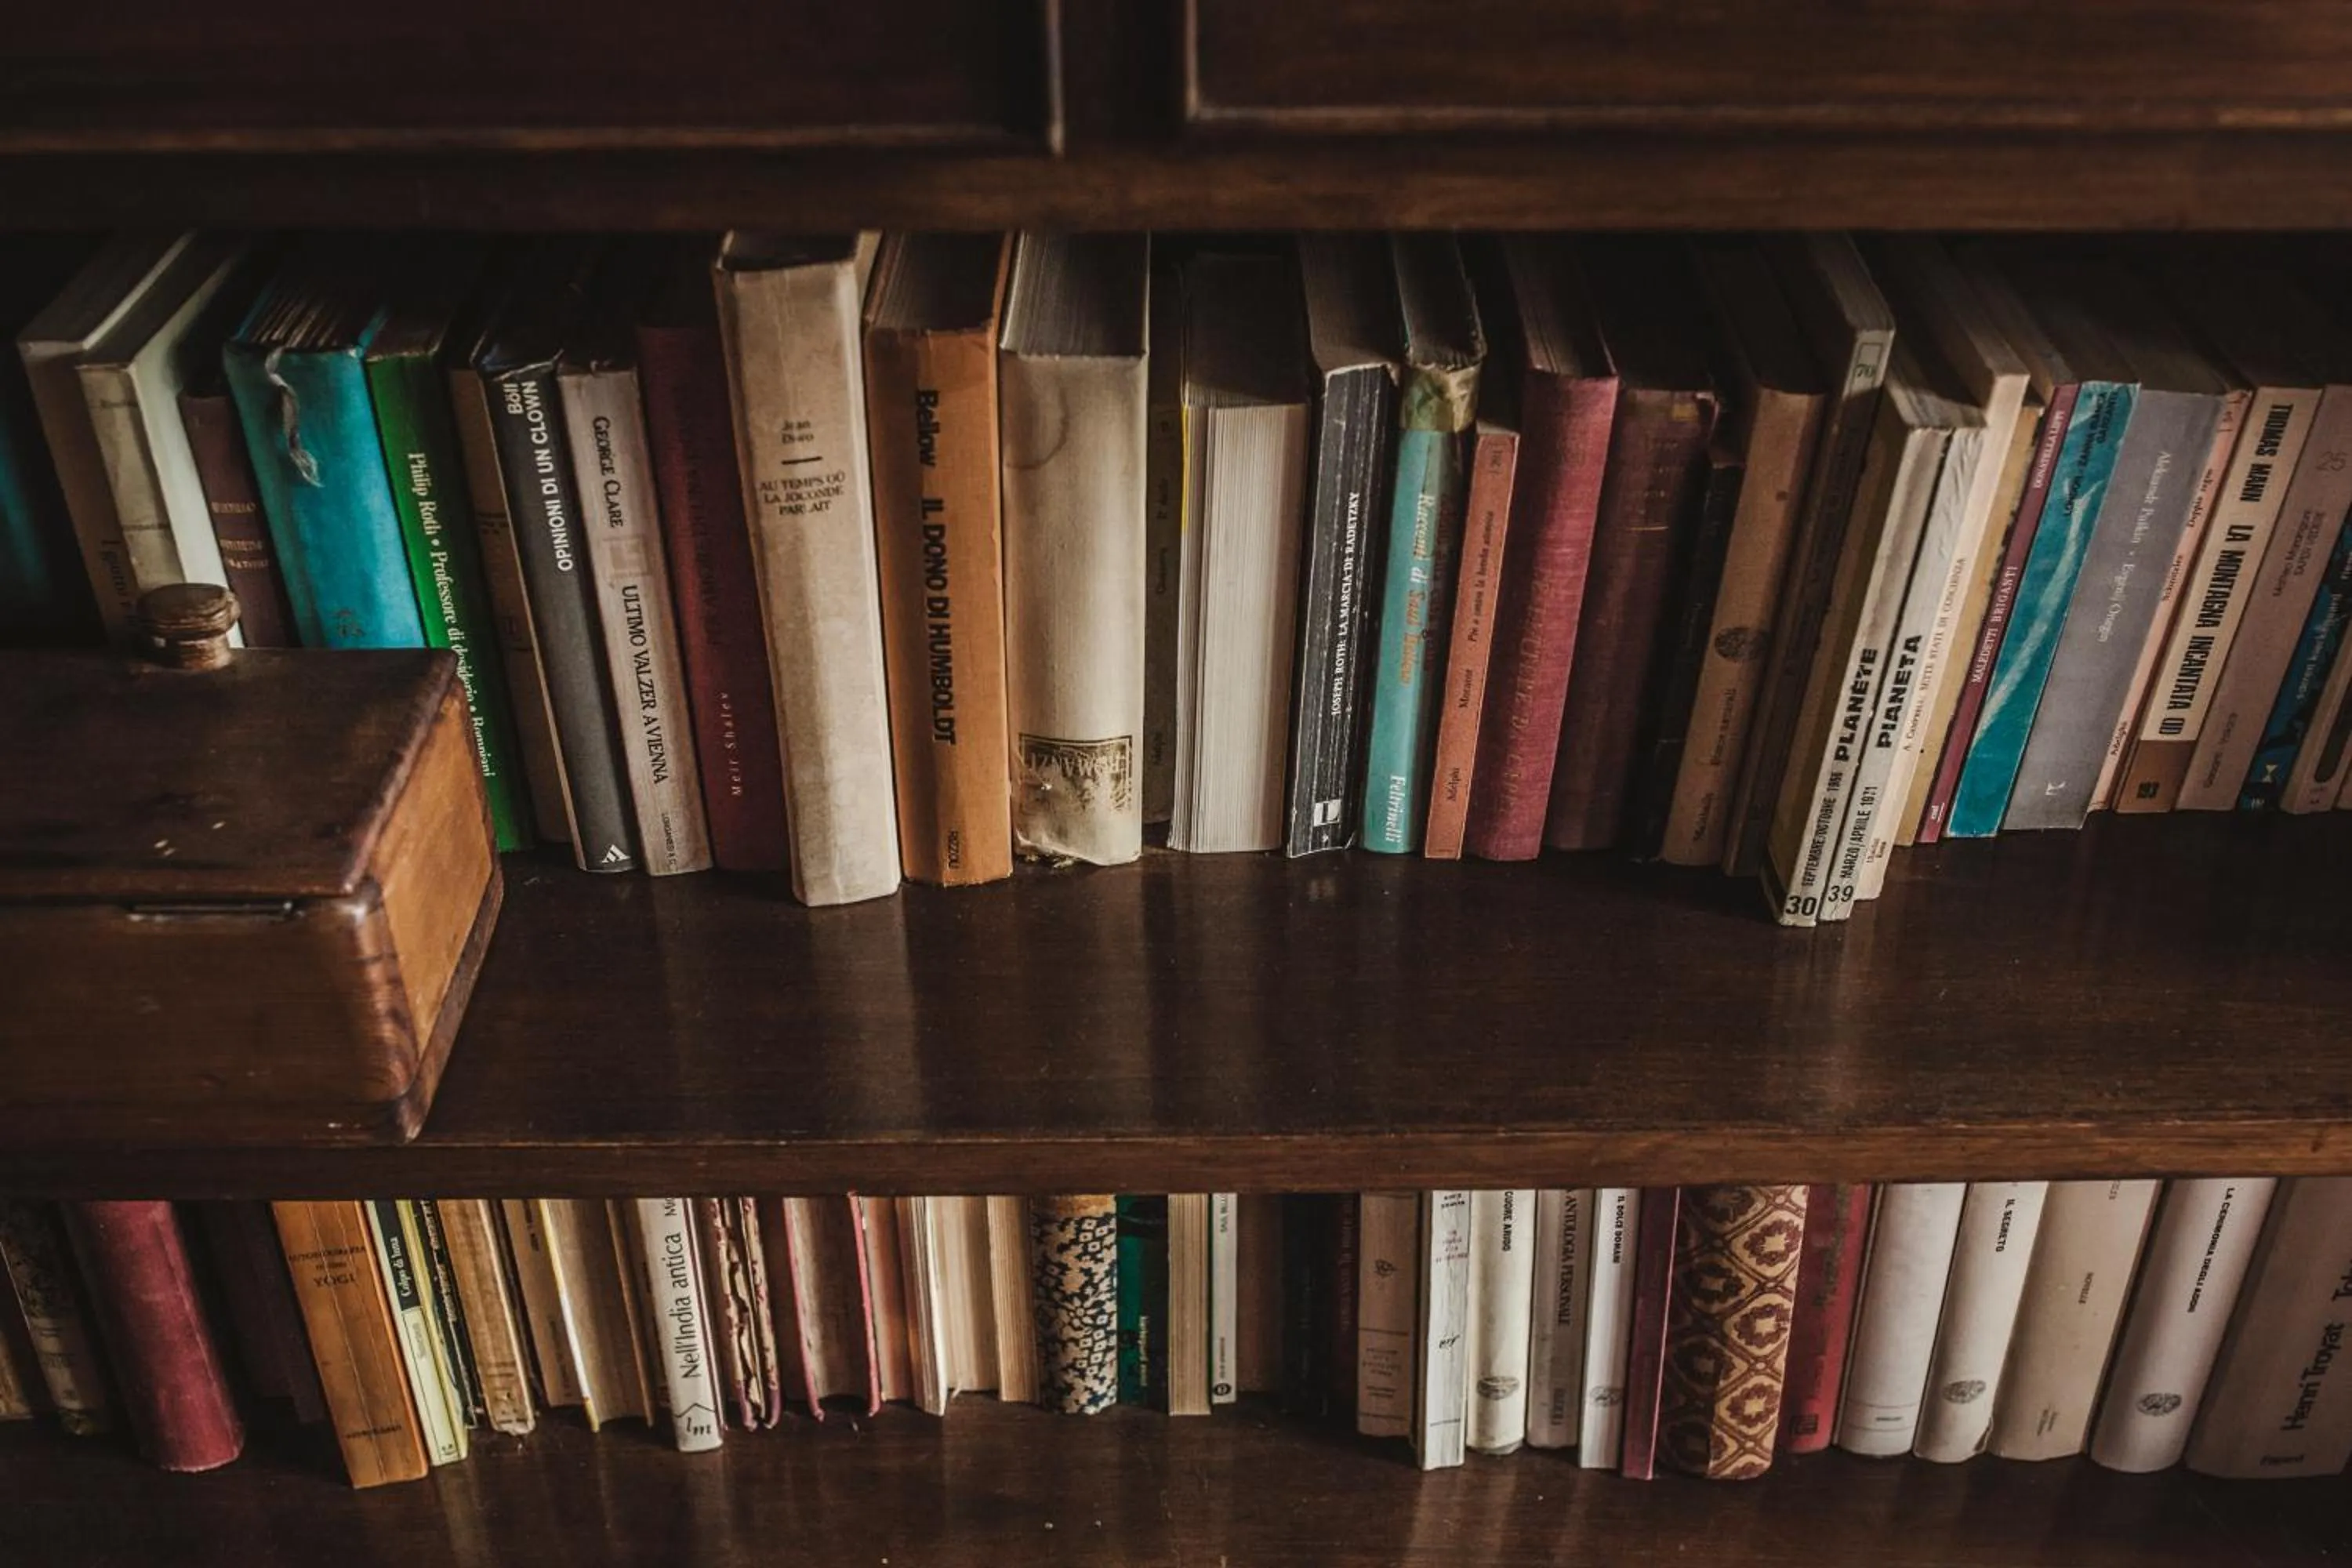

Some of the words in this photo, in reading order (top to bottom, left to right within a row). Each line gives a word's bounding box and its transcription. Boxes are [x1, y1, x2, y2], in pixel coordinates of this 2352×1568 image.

[503, 382, 524, 416] Böll
[521, 380, 548, 445] CLOWN
[593, 416, 616, 477] GEORGE
[916, 392, 942, 467] Bellow
[2258, 404, 2294, 457] THOMAS
[407, 451, 435, 497] Philip
[533, 448, 554, 474] UN
[781, 477, 825, 490] TEMPS
[2239, 463, 2272, 503] MANN
[540, 477, 559, 495] DI
[602, 479, 624, 528] CLARE
[764, 493, 782, 503] LA
[779, 500, 832, 515] PARAIT
[920, 498, 946, 521] IL
[417, 501, 442, 535] Roth
[546, 499, 574, 572] OPINIONI
[1343, 490, 1362, 555] RADETZKY
[2225, 524, 2255, 543] LA
[921, 524, 949, 592] DONO
[1409, 566, 1432, 584] di
[430, 550, 458, 625] Professore
[448, 626, 465, 641] di
[925, 595, 951, 618] DI
[1338, 575, 1353, 622] MARCIA
[2194, 549, 2245, 628] MONTAGNA
[621, 584, 647, 647] ULTIMO
[1335, 622, 1349, 637] LA
[1970, 627, 2000, 684] MALEDETTI
[1991, 564, 2019, 623] BRIGANTI
[1929, 632, 1944, 659] STATI
[2167, 586, 2215, 710] INCANTATA
[630, 648, 655, 711] VALZER
[928, 623, 957, 746] HUMBOLDT
[1330, 676, 1345, 717] JOSEPH
[1457, 668, 1474, 709] Morante
[1873, 633, 1922, 750] PIANETA
[641, 714, 655, 728] A
[644, 728, 670, 785] VIENNA
[1838, 809, 1872, 879] MARZO/APRILE
[1858, 786, 1878, 807] 1971
[1784, 895, 1817, 916] 30
[1827, 884, 1855, 903] 39
[1995, 1210, 2013, 1253] SEGRETO
[2206, 1202, 2231, 1256] CERIMONIA
[314, 1273, 355, 1287] YOGI
[660, 1232, 689, 1290] antica
[668, 1295, 702, 1379] Nell'India
[2279, 1381, 2321, 1432] Henri
[2301, 1323, 2345, 1381] Troyat
